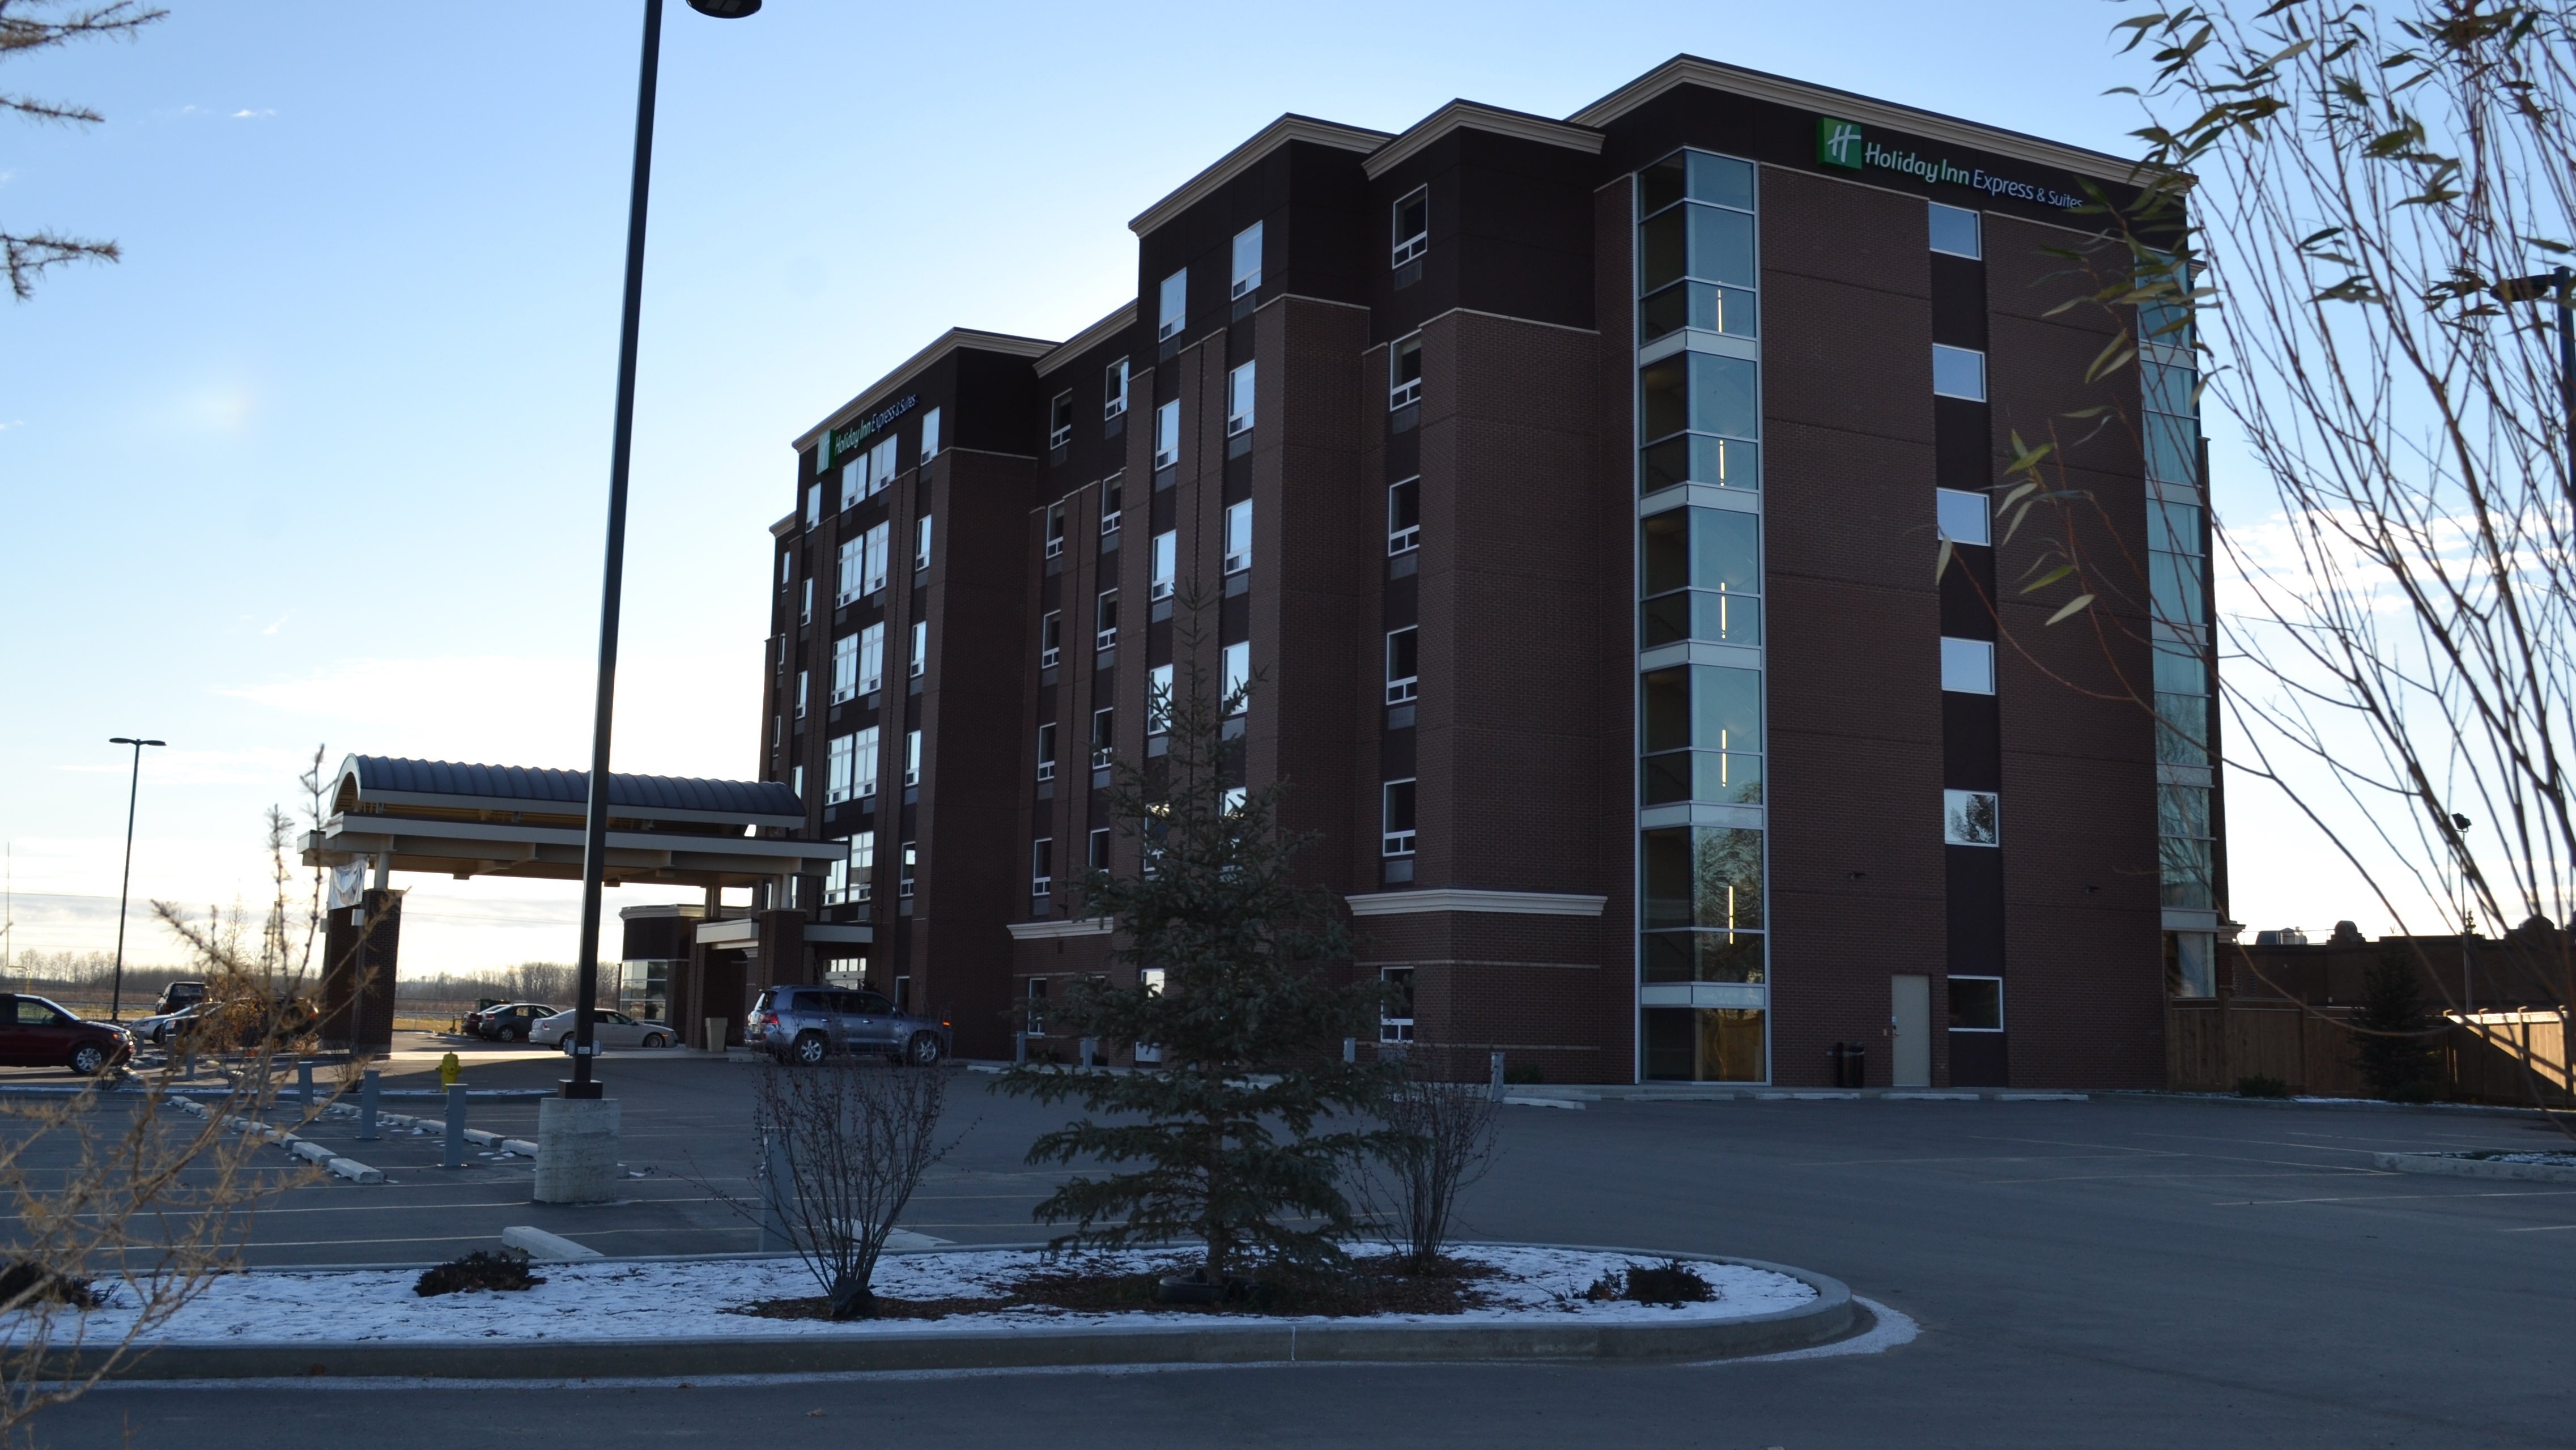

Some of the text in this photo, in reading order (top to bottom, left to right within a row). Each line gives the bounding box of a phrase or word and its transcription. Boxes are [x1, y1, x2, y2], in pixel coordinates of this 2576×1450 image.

[1864, 142, 1939, 183] Holiday
[1941, 159, 1970, 185] Inn
[1973, 169, 2034, 199] Express
[2037, 188, 2046, 202] &
[834, 427, 860, 457] Holiday
[860, 419, 872, 440] Inn
[872, 405, 895, 433] Express
